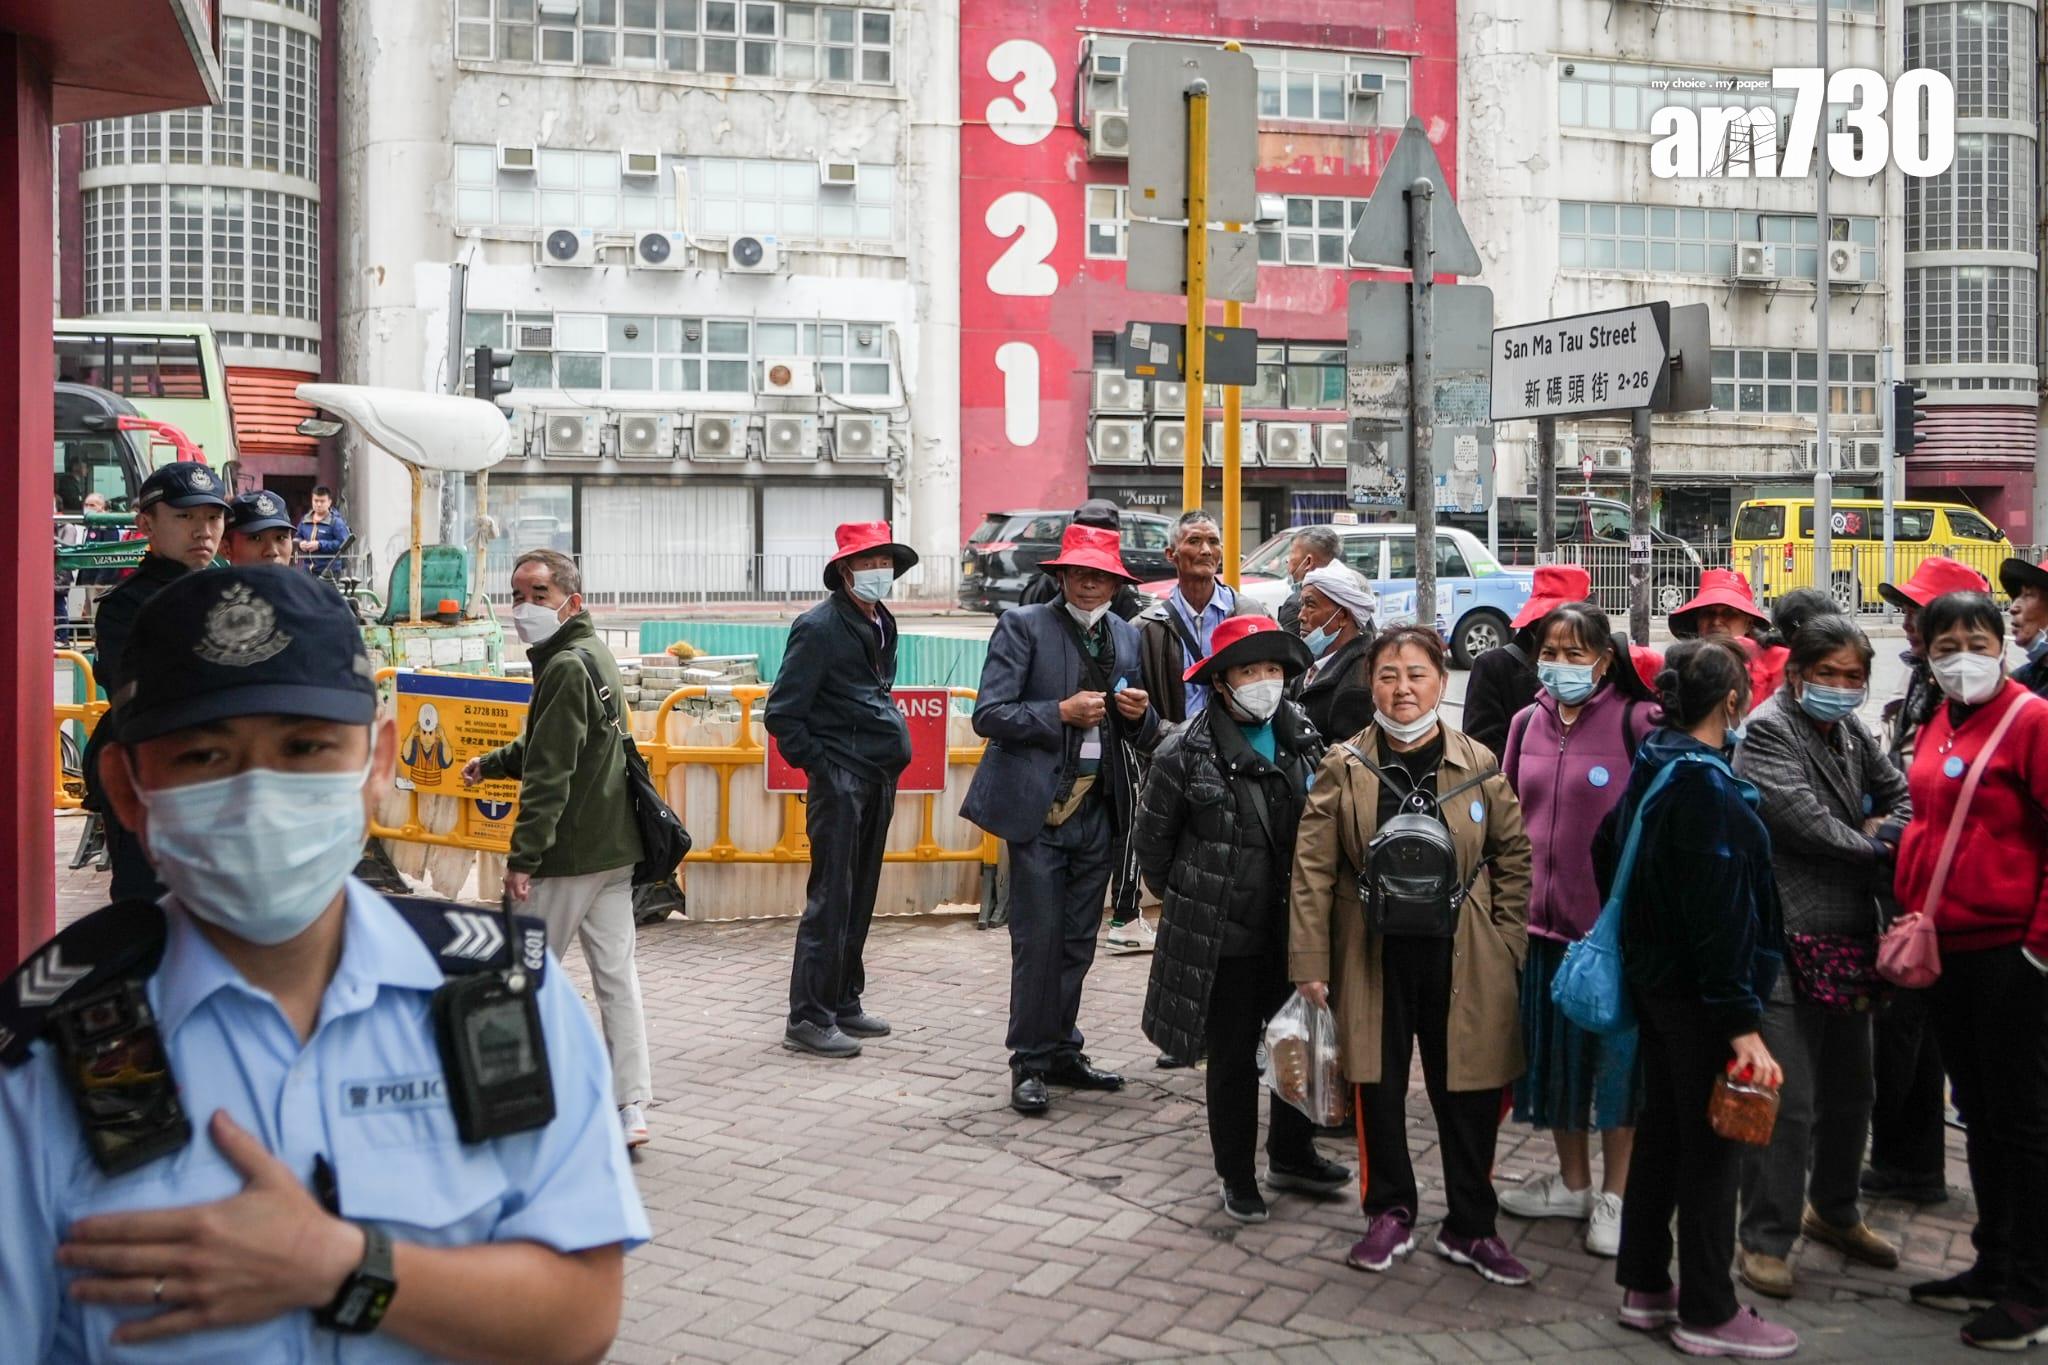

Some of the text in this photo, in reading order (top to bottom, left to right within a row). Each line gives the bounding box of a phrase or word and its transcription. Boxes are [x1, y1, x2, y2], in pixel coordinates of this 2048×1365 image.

[985, 39, 1059, 145] 3
[984, 191, 1060, 296] 2
[1504, 321, 1637, 360] San Ma Tau Street
[994, 342, 1039, 446] 1
[1525, 372, 1609, 409] 新碼頭街
[1518, 581, 1533, 593] TA
